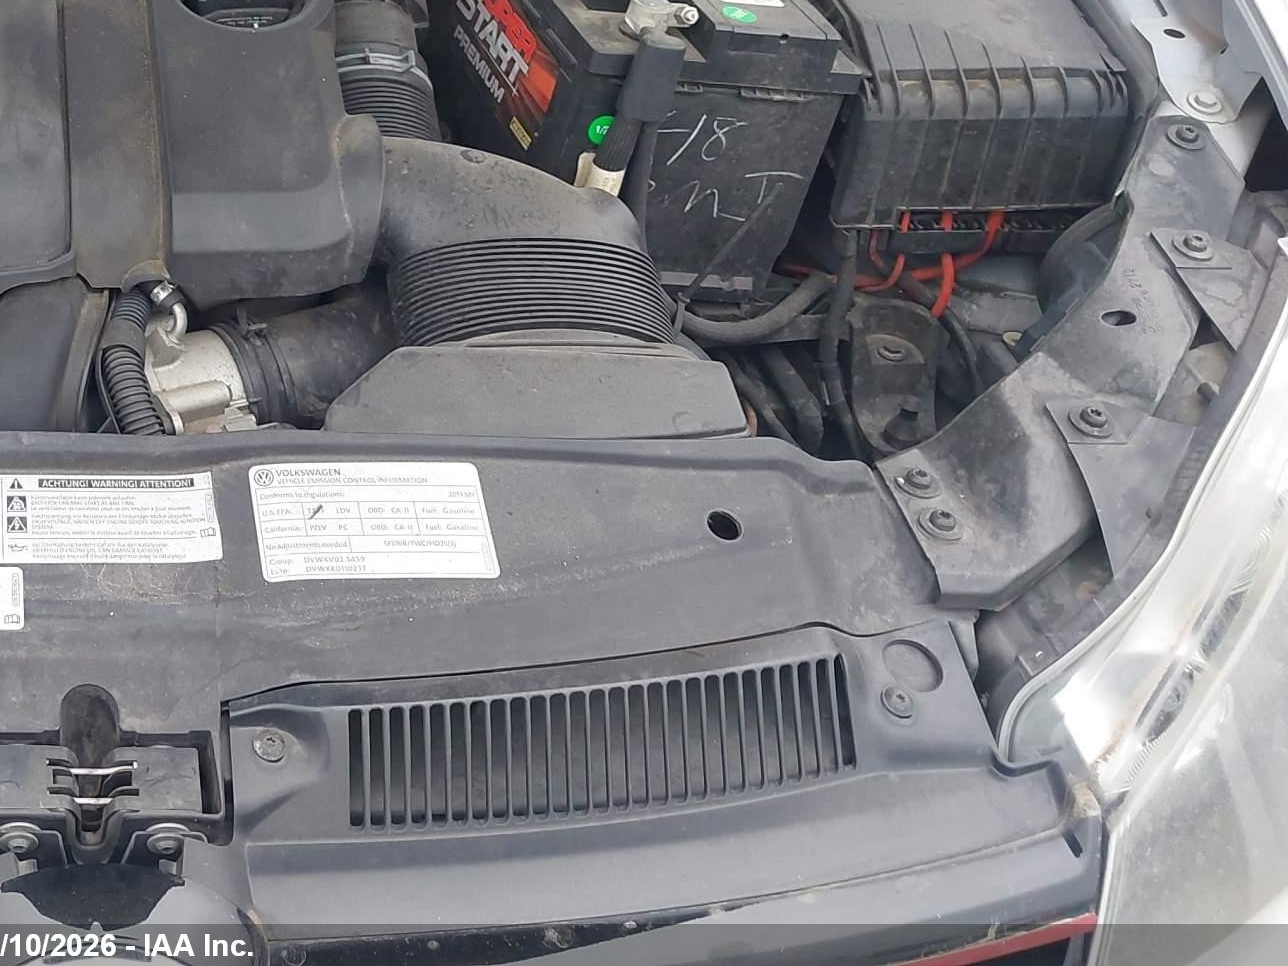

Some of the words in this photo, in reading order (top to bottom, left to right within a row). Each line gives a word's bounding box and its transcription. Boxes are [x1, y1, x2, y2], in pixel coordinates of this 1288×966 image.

[454, 24, 505, 103] PREMIUM
[275, 468, 341, 477] VOLKSWAGEN
[42, 480, 89, 488] ACHTUNG!
[91, 480, 138, 488] WARNING!
[139, 479, 191, 488] ATTENTION!
[277, 477, 305, 485] VEHICLE
[342, 476, 377, 484] CONTROL
[377, 475, 428, 484] INFORMATION
[446, 523, 478, 531] Gasoline
